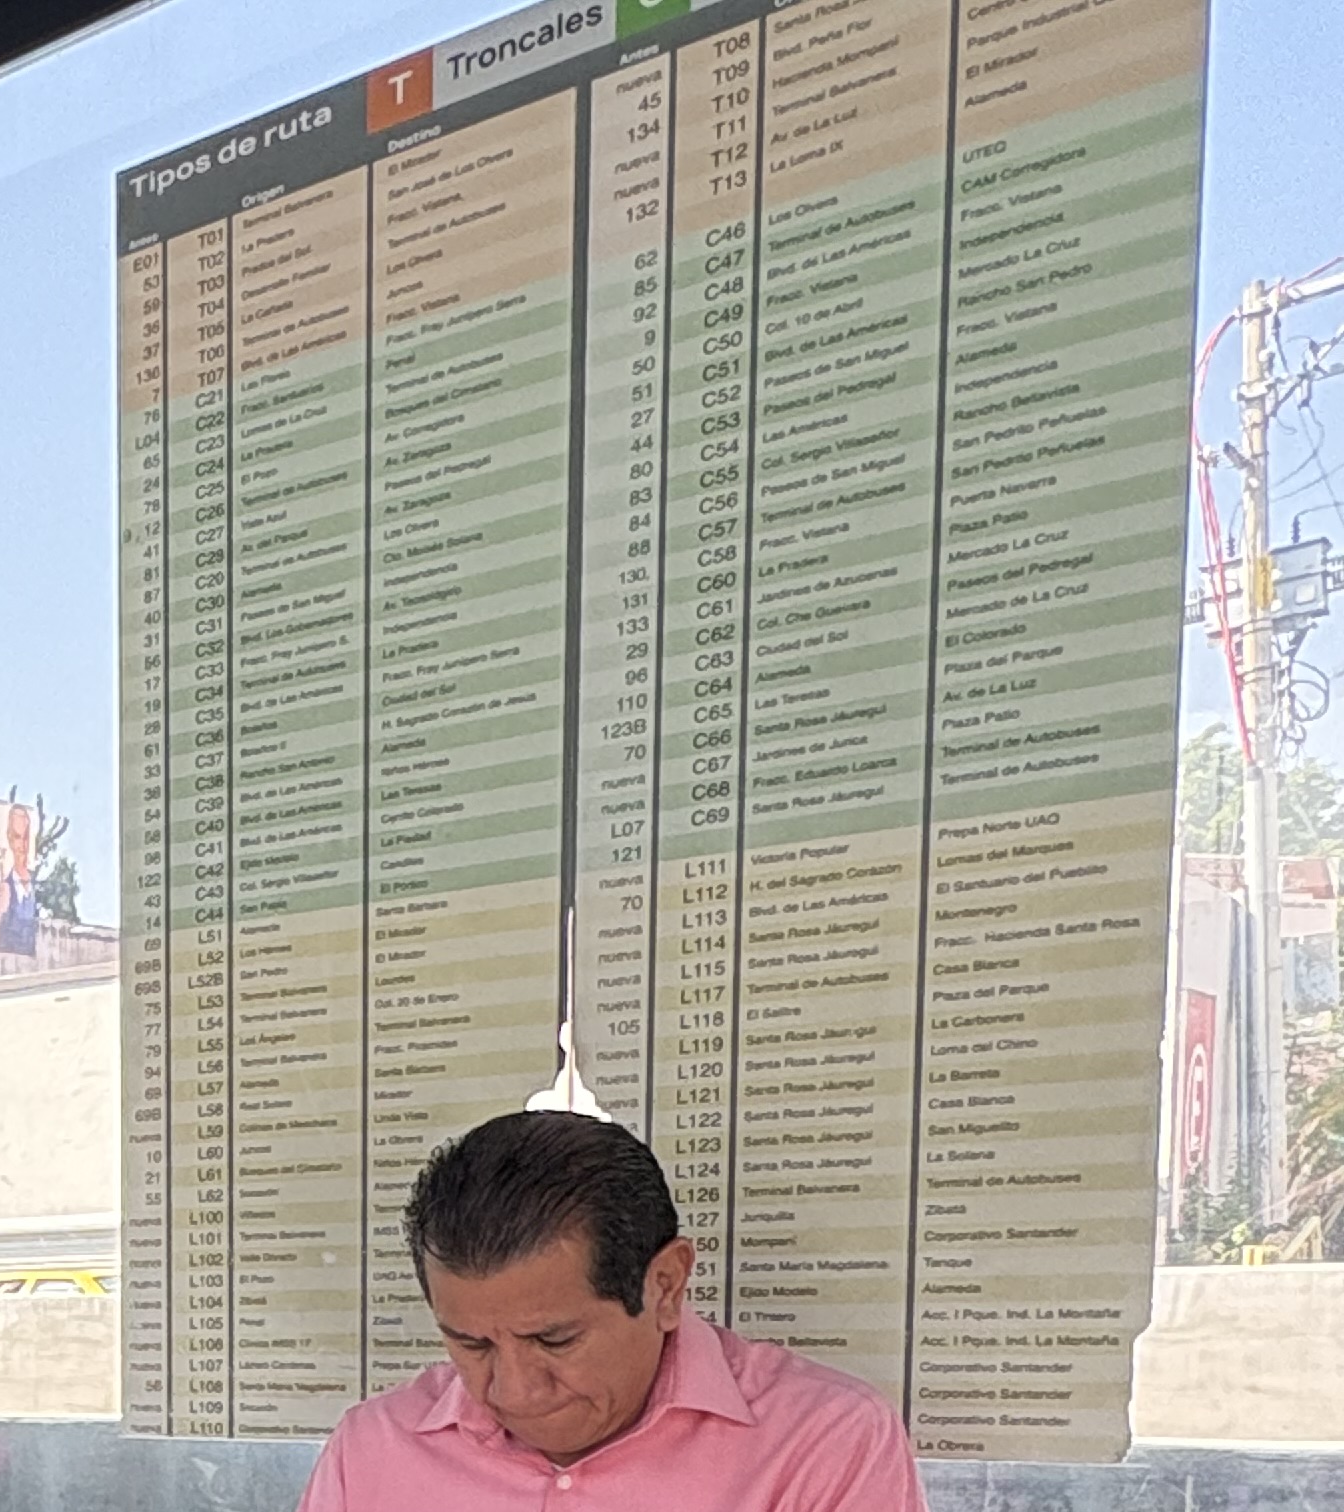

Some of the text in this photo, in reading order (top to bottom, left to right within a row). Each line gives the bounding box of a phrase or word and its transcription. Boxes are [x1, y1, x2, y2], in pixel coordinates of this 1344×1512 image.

[713, 32, 750, 58] T08
[388, 6, 604, 106] T Troncales
[638, 91, 661, 111] 45
[712, 88, 750, 113] T10
[627, 118, 660, 143] 134
[129, 105, 332, 198] Tipos de ruta
[710, 142, 748, 168] T12
[709, 170, 747, 195] T13
[626, 199, 660, 223] 132
[705, 221, 745, 247] C46
[634, 250, 658, 270] 62
[705, 249, 745, 274] C47
[703, 331, 743, 355] C50
[632, 356, 655, 375] 50
[702, 385, 742, 408] C52
[701, 411, 741, 435] C53
[630, 461, 653, 480] 80
[698, 518, 738, 541] C57
[697, 571, 736, 593] C60
[696, 624, 735, 646] C62
[617, 693, 648, 712] 110
[694, 703, 733, 723] C65
[692, 781, 730, 801] C68
[691, 807, 729, 826] C69
[611, 820, 645, 839] L07
[685, 859, 726, 879] L111
[682, 909, 727, 929] L113
[680, 986, 726, 1004] L117
[608, 1019, 640, 1036] 105
[678, 1062, 723, 1080] L120
[676, 1112, 722, 1129] L122
[675, 1162, 721, 1179] L124
[189, 1211, 223, 1226] L100
[189, 1274, 223, 1288] L103
[189, 1359, 223, 1372] L107
